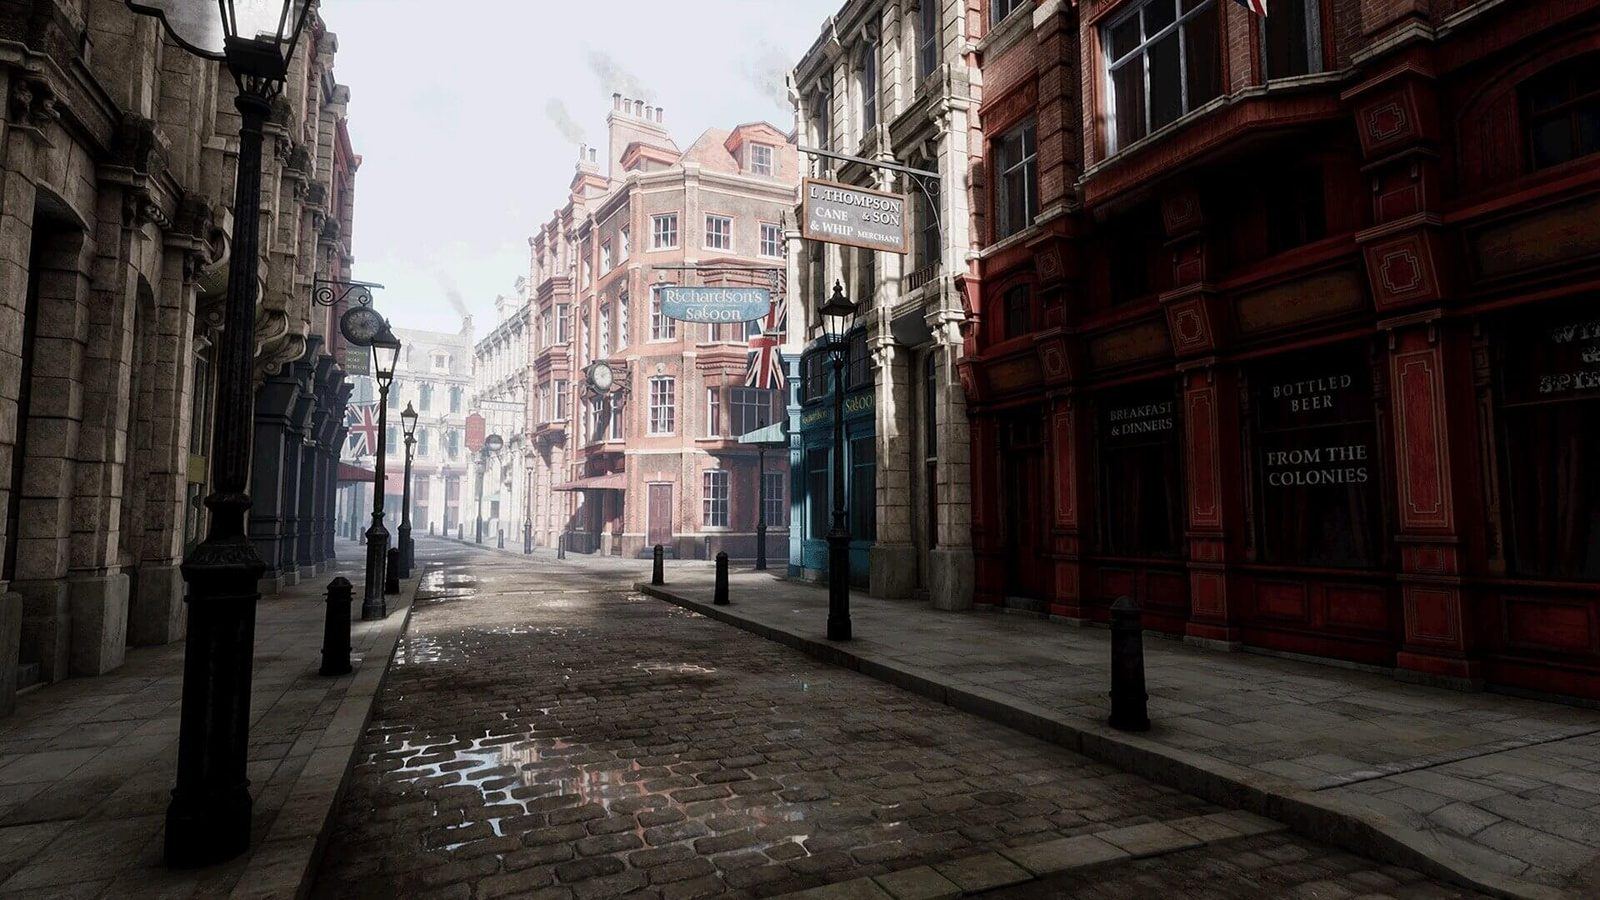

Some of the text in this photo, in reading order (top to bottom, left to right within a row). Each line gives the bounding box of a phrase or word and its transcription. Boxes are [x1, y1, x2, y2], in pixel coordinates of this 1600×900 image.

[815, 207, 848, 221] CANE
[861, 212, 900, 226] & SON
[810, 221, 900, 244] & WHIP MERCHANT
[666, 289, 762, 303] Richardson's
[686, 305, 740, 320] Saloon
[1272, 374, 1352, 398] BOTTLED
[1110, 401, 1172, 421] BREAKFAST
[1291, 395, 1333, 412] BEER
[1111, 418, 1173, 436] & DINNERS
[1267, 445, 1368, 466] FROM THE
[1268, 466, 1368, 486] COLONIES
